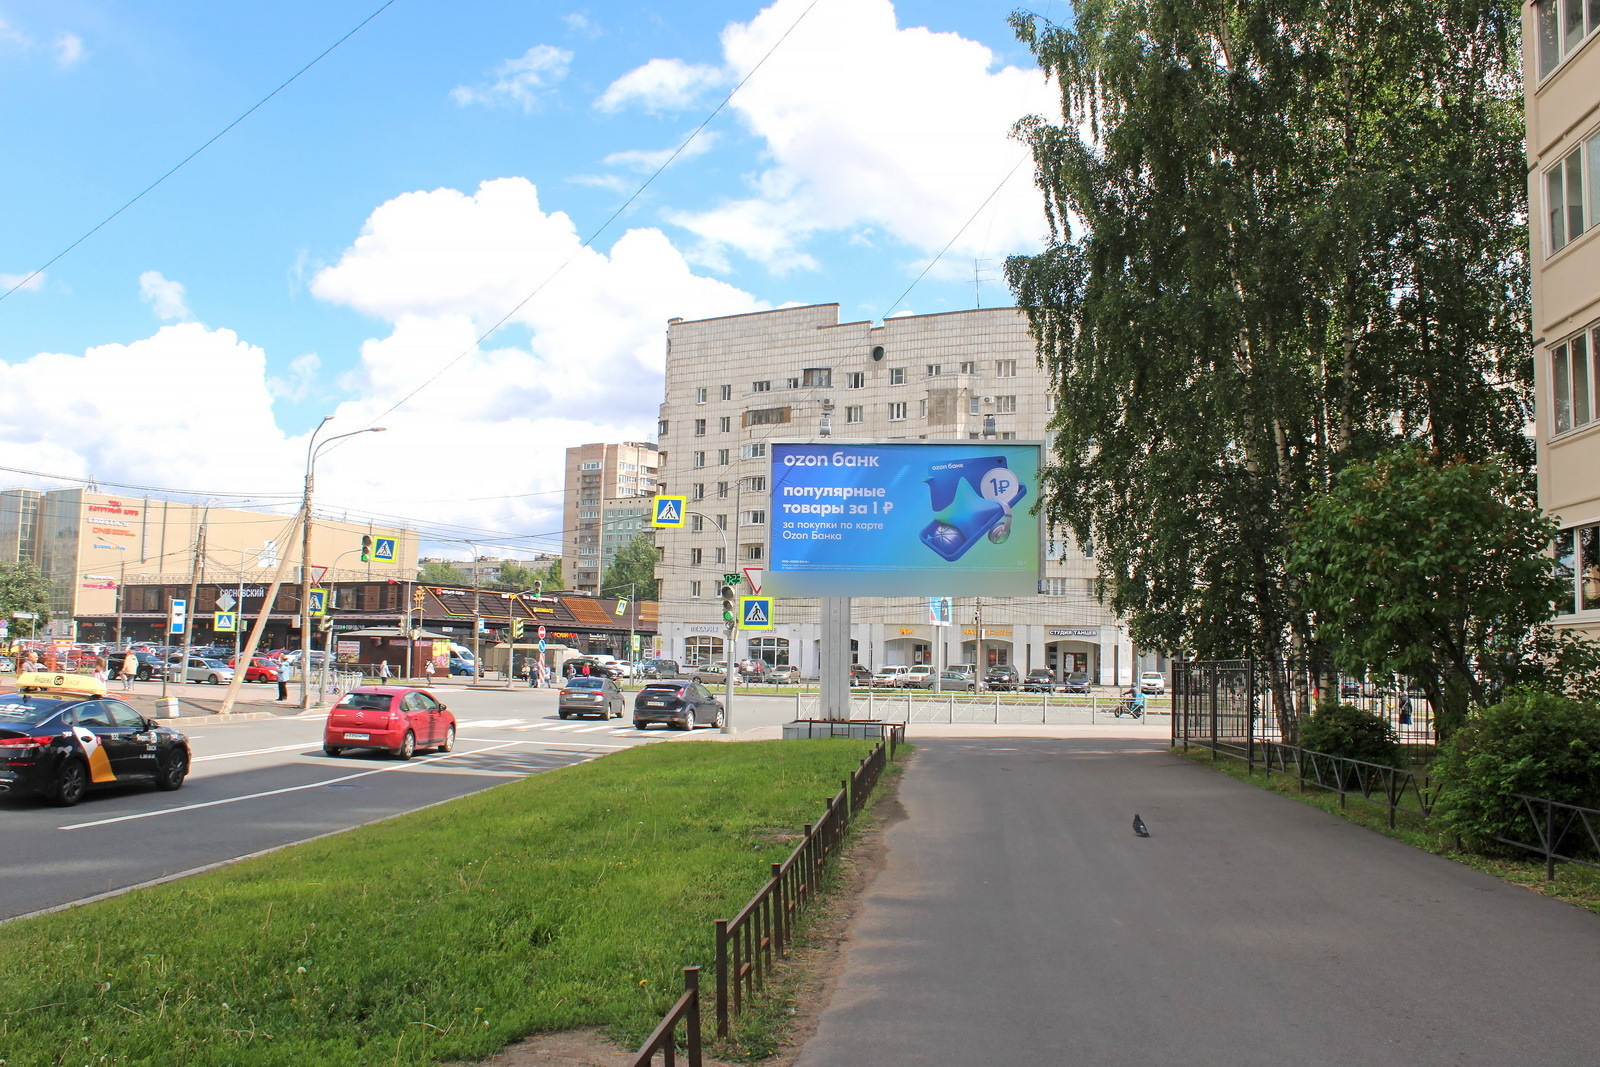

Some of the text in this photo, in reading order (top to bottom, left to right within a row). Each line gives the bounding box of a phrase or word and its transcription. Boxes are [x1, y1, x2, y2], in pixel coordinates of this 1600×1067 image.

[783, 451, 880, 467] ozon банк
[783, 486, 886, 500] популярные
[782, 503, 845, 517] товары
[848, 504, 868, 514] за
[872, 501, 878, 514] 1
[782, 521, 794, 529] за
[797, 522, 838, 530] покупки
[855, 522, 884, 532] карте
[782, 530, 842, 540] Ozon Банка
